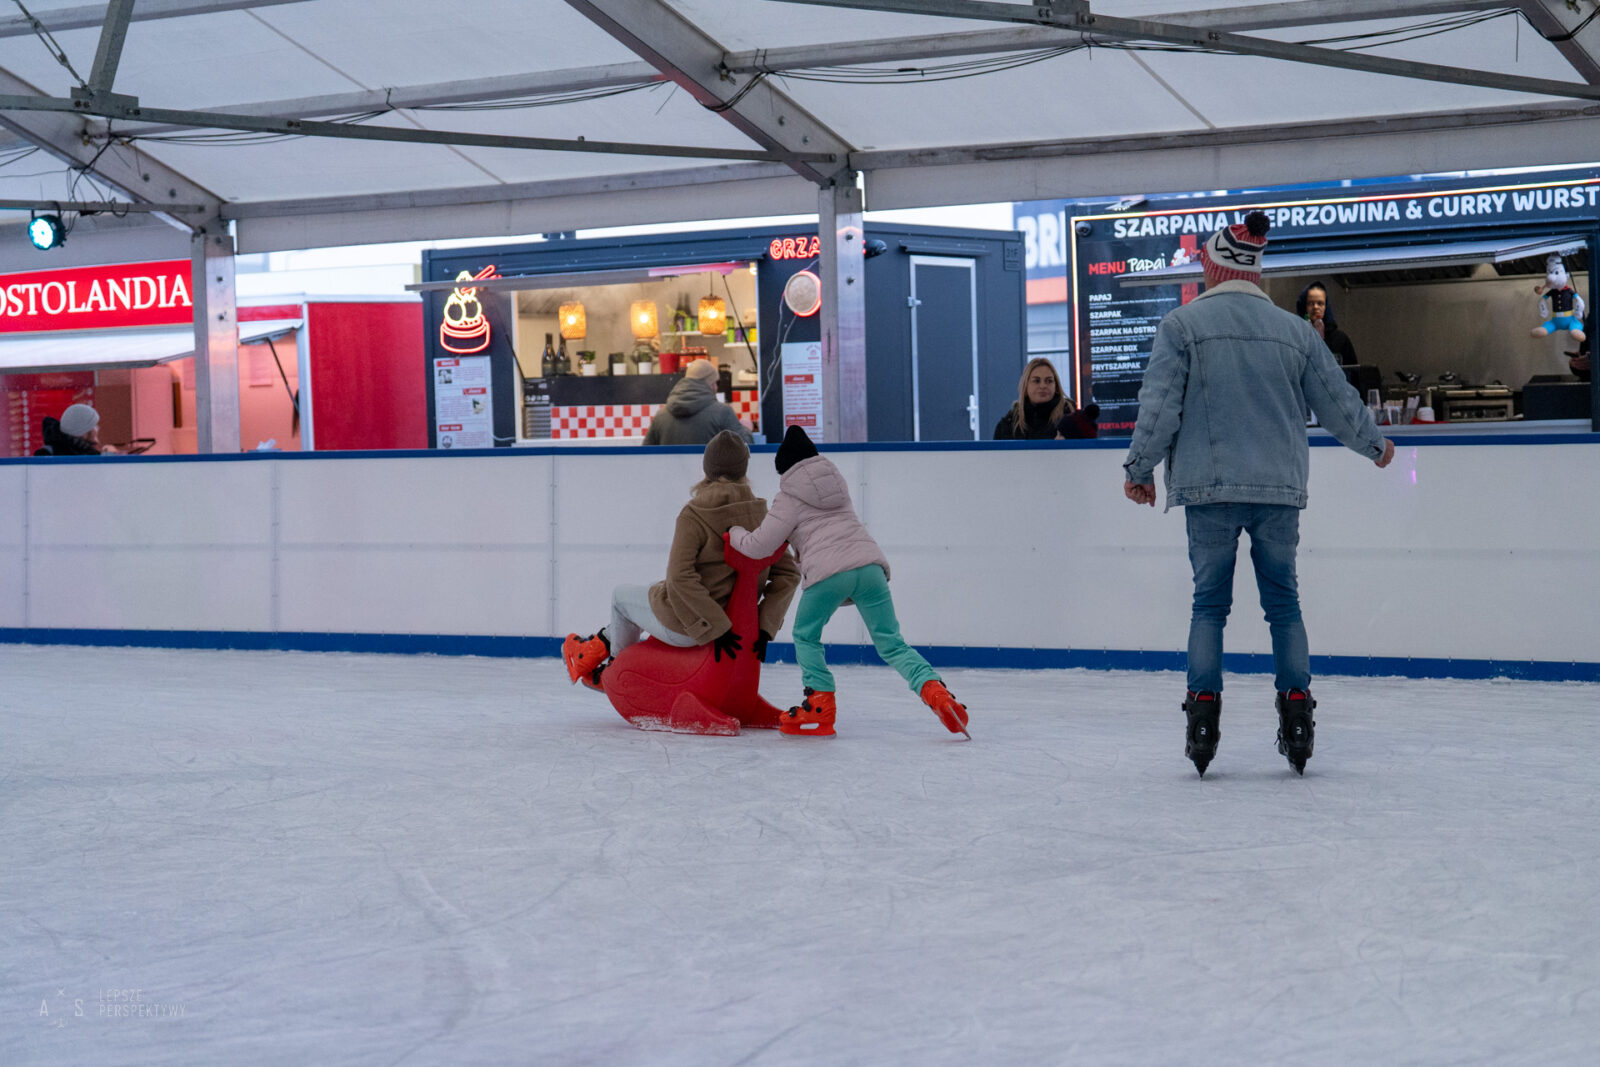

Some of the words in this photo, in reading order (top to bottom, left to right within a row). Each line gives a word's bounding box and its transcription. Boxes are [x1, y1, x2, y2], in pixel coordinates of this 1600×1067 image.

[1114, 212, 1228, 239] SZARPANA
[1405, 200, 1423, 219] &
[1428, 193, 1507, 218] CURRY
[1512, 185, 1600, 212] WURST
[770, 236, 821, 260] GRZA
[1088, 261, 1126, 275] MENU
[0, 274, 192, 316] STOLANDIA
[1089, 294, 1112, 302] PAPAJ
[1089, 311, 1121, 319] SZARPAK
[1090, 328, 1121, 336] SZARPAK
[1123, 327, 1132, 335] NA
[1133, 326, 1157, 334] OSTRO
[1091, 345, 1122, 354] SZARPAK
[1123, 344, 1138, 352] BOX
[1091, 362, 1141, 371] FRYTSZARPAK
[1098, 422, 1119, 430] FERTA
